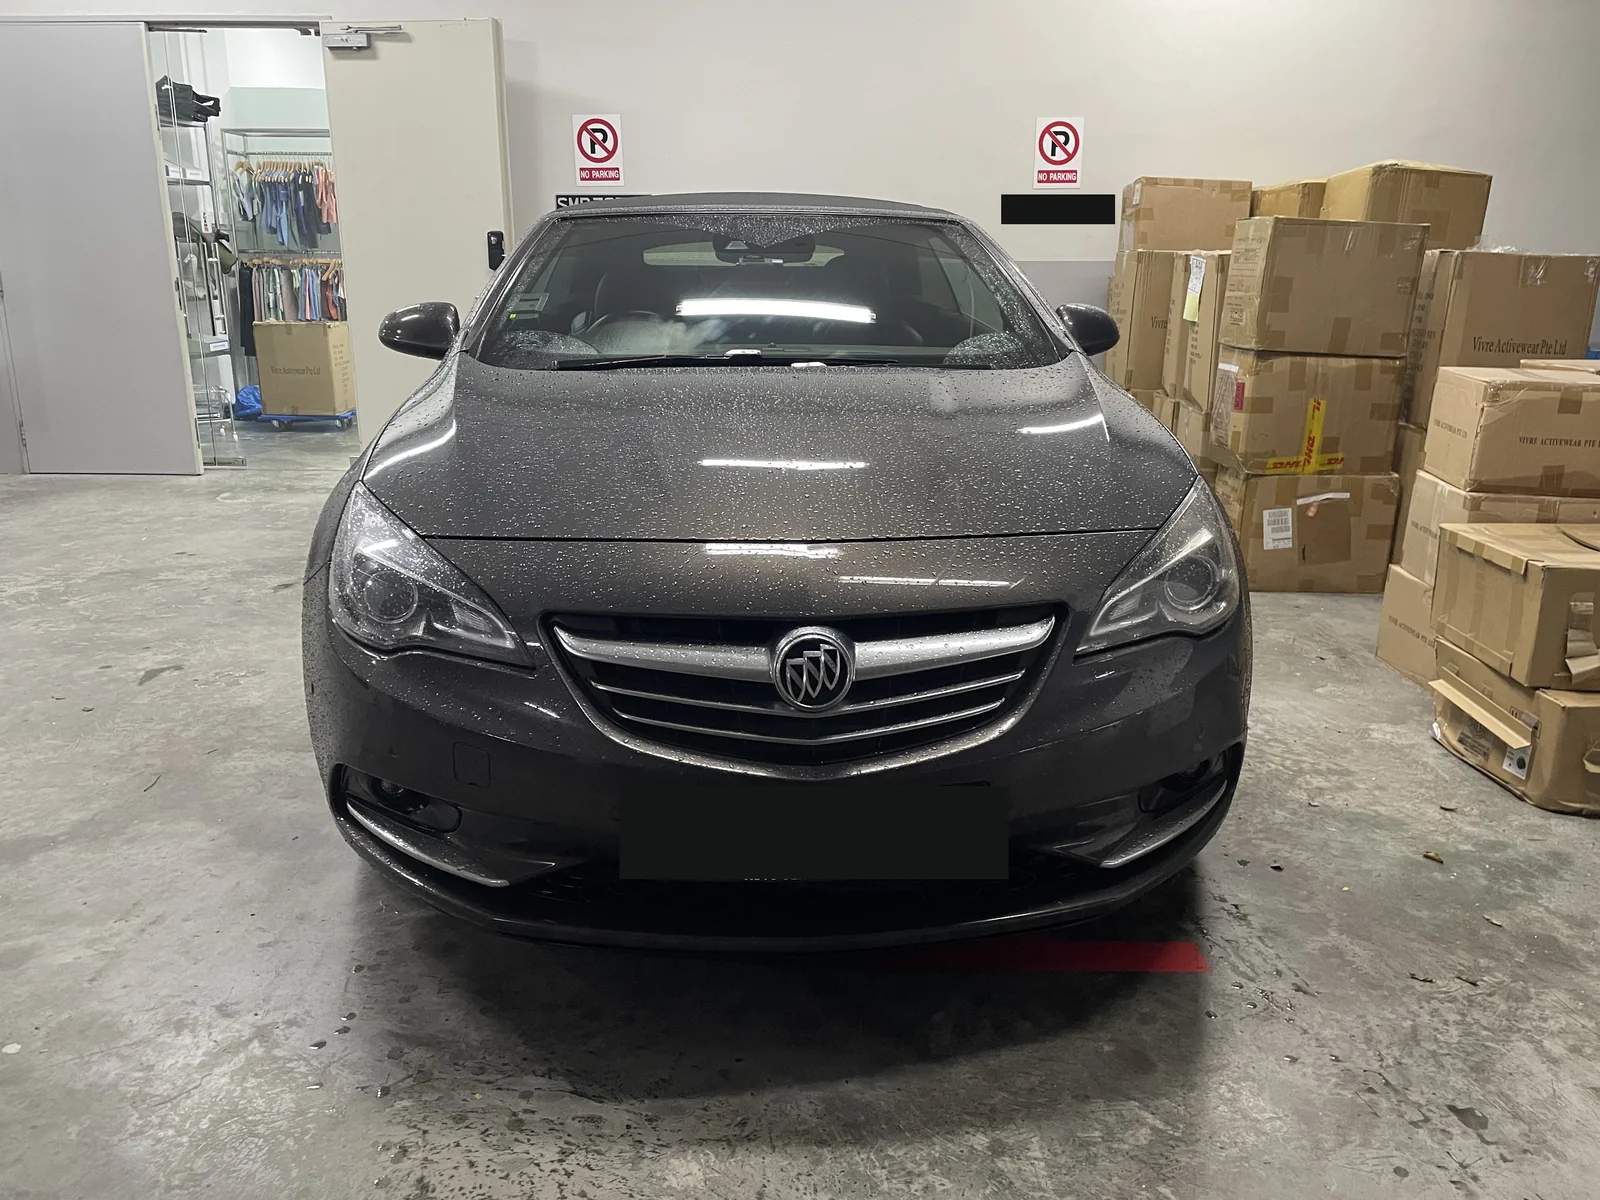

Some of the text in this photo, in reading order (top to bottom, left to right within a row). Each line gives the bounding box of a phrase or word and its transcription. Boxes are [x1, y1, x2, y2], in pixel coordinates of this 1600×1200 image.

[580, 170, 619, 179] NO PARKING
[1037, 172, 1077, 181] NO PARKING
[1473, 336, 1568, 355] Vivre Activewear Pte Ltd
[1519, 436, 1538, 445] VIVRE
[1540, 437, 1582, 447] ACTIVEWEAR
[1583, 439, 1597, 448] PTE
